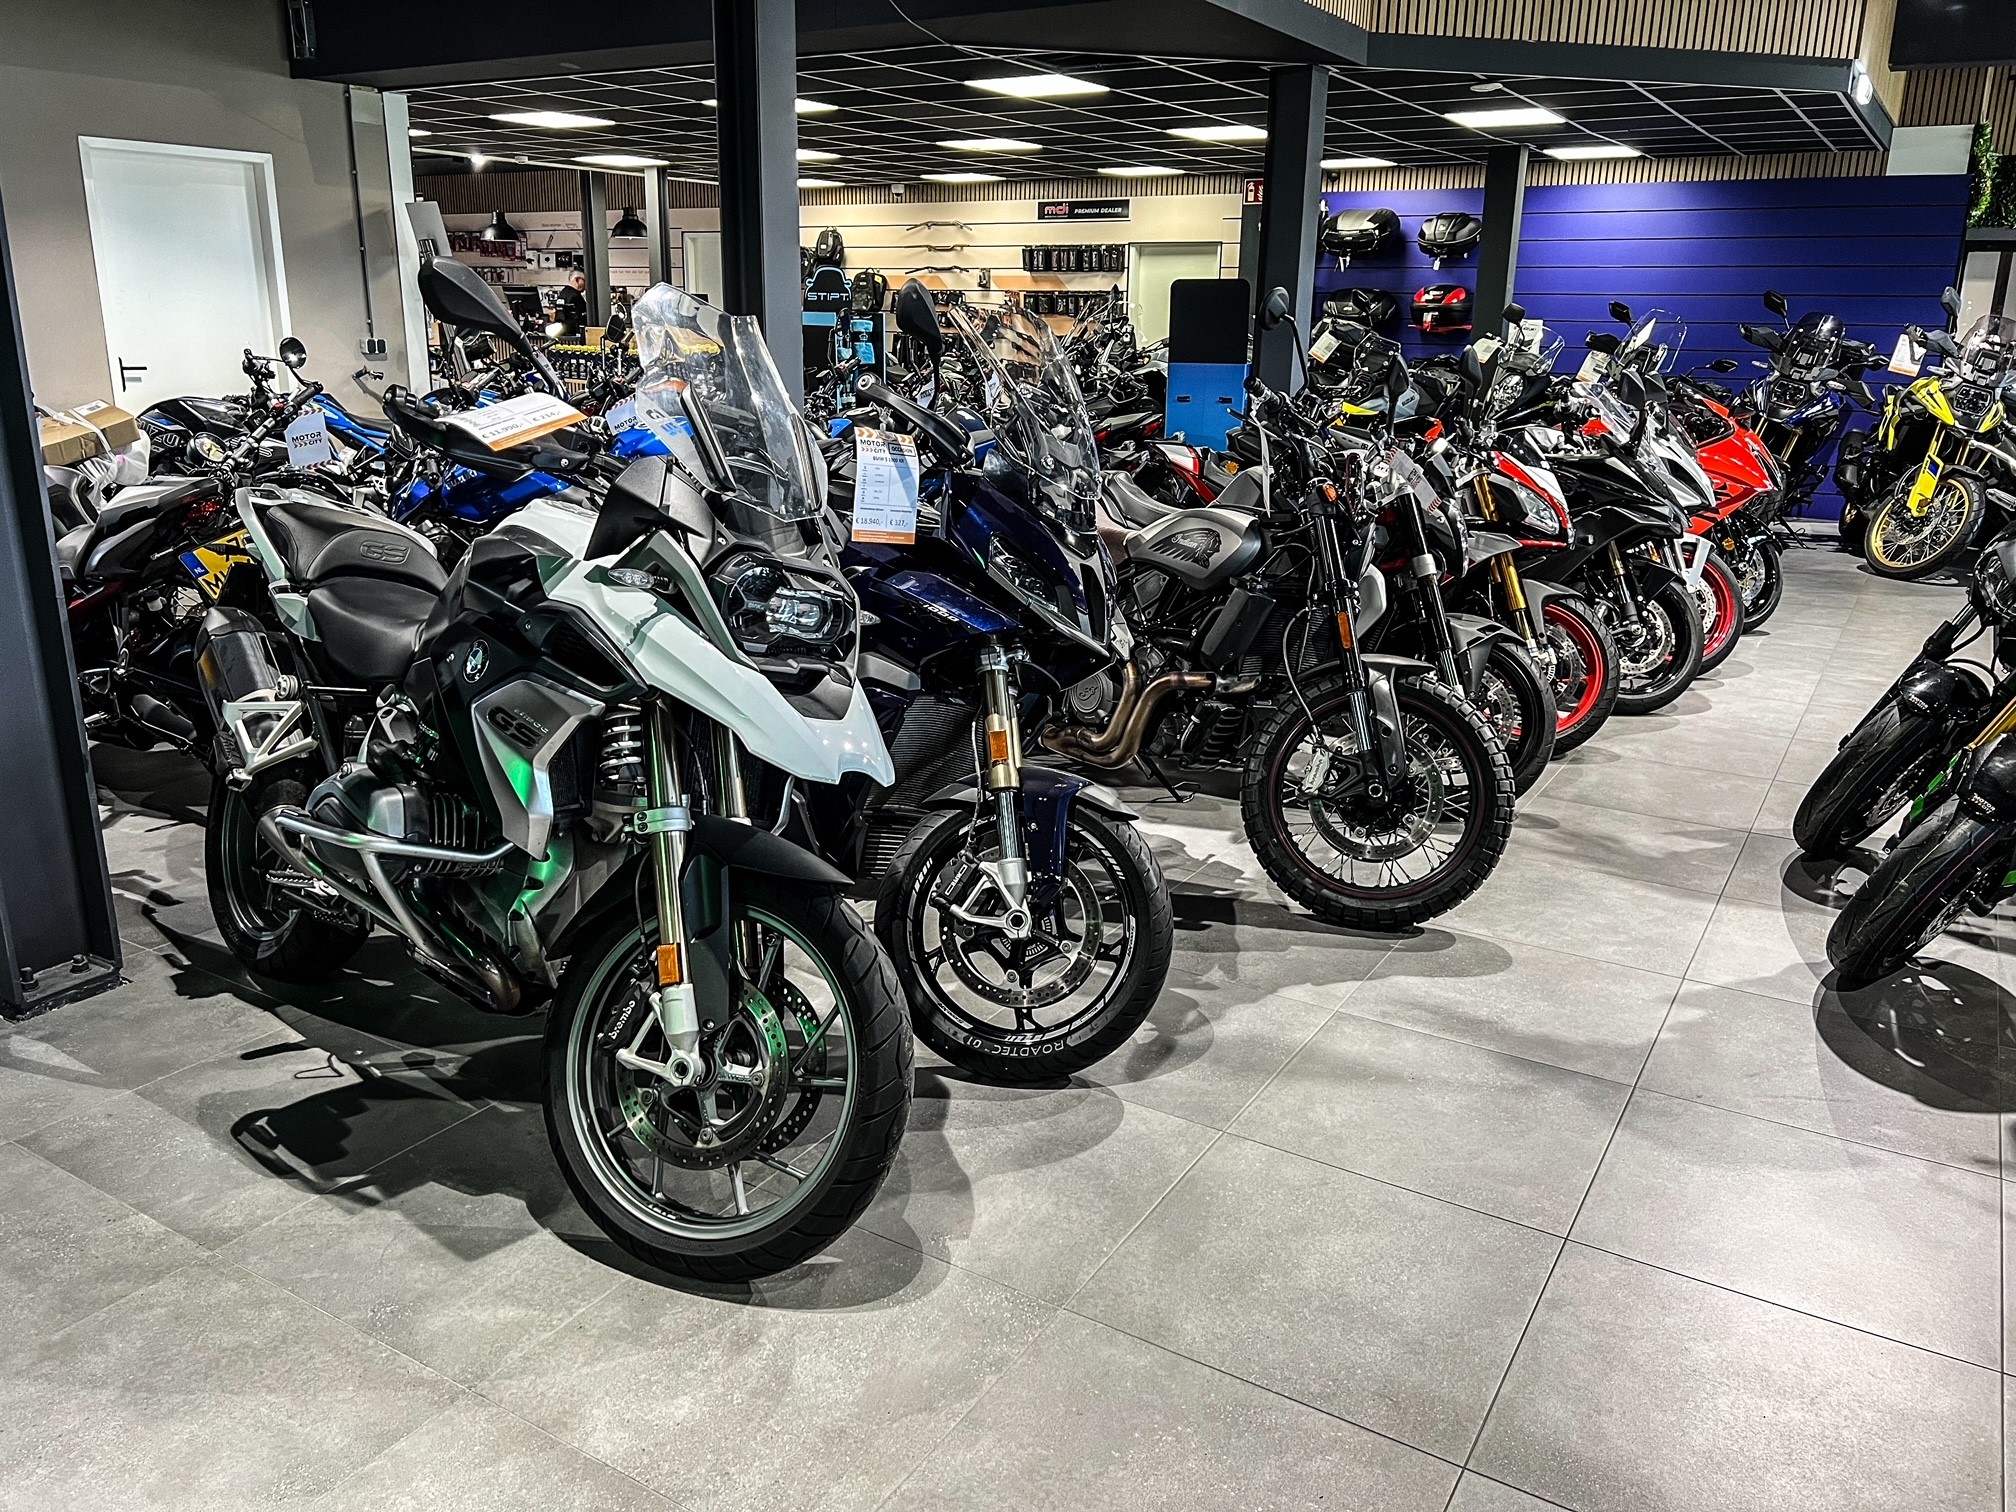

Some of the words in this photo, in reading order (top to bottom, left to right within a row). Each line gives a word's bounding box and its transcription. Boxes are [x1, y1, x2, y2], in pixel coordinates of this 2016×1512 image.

[291, 431, 322, 443] MOTOR
[860, 439, 886, 448] MOTOR
[860, 517, 883, 526] 18.940,-
[894, 519, 909, 527] 327,-
[1171, 533, 1198, 549] Indian
[361, 541, 408, 563] GS
[487, 706, 542, 747] GS
[608, 1000, 636, 1040] brembo
[966, 1036, 982, 1048] 01
[991, 1039, 1064, 1057] ROADTEC
